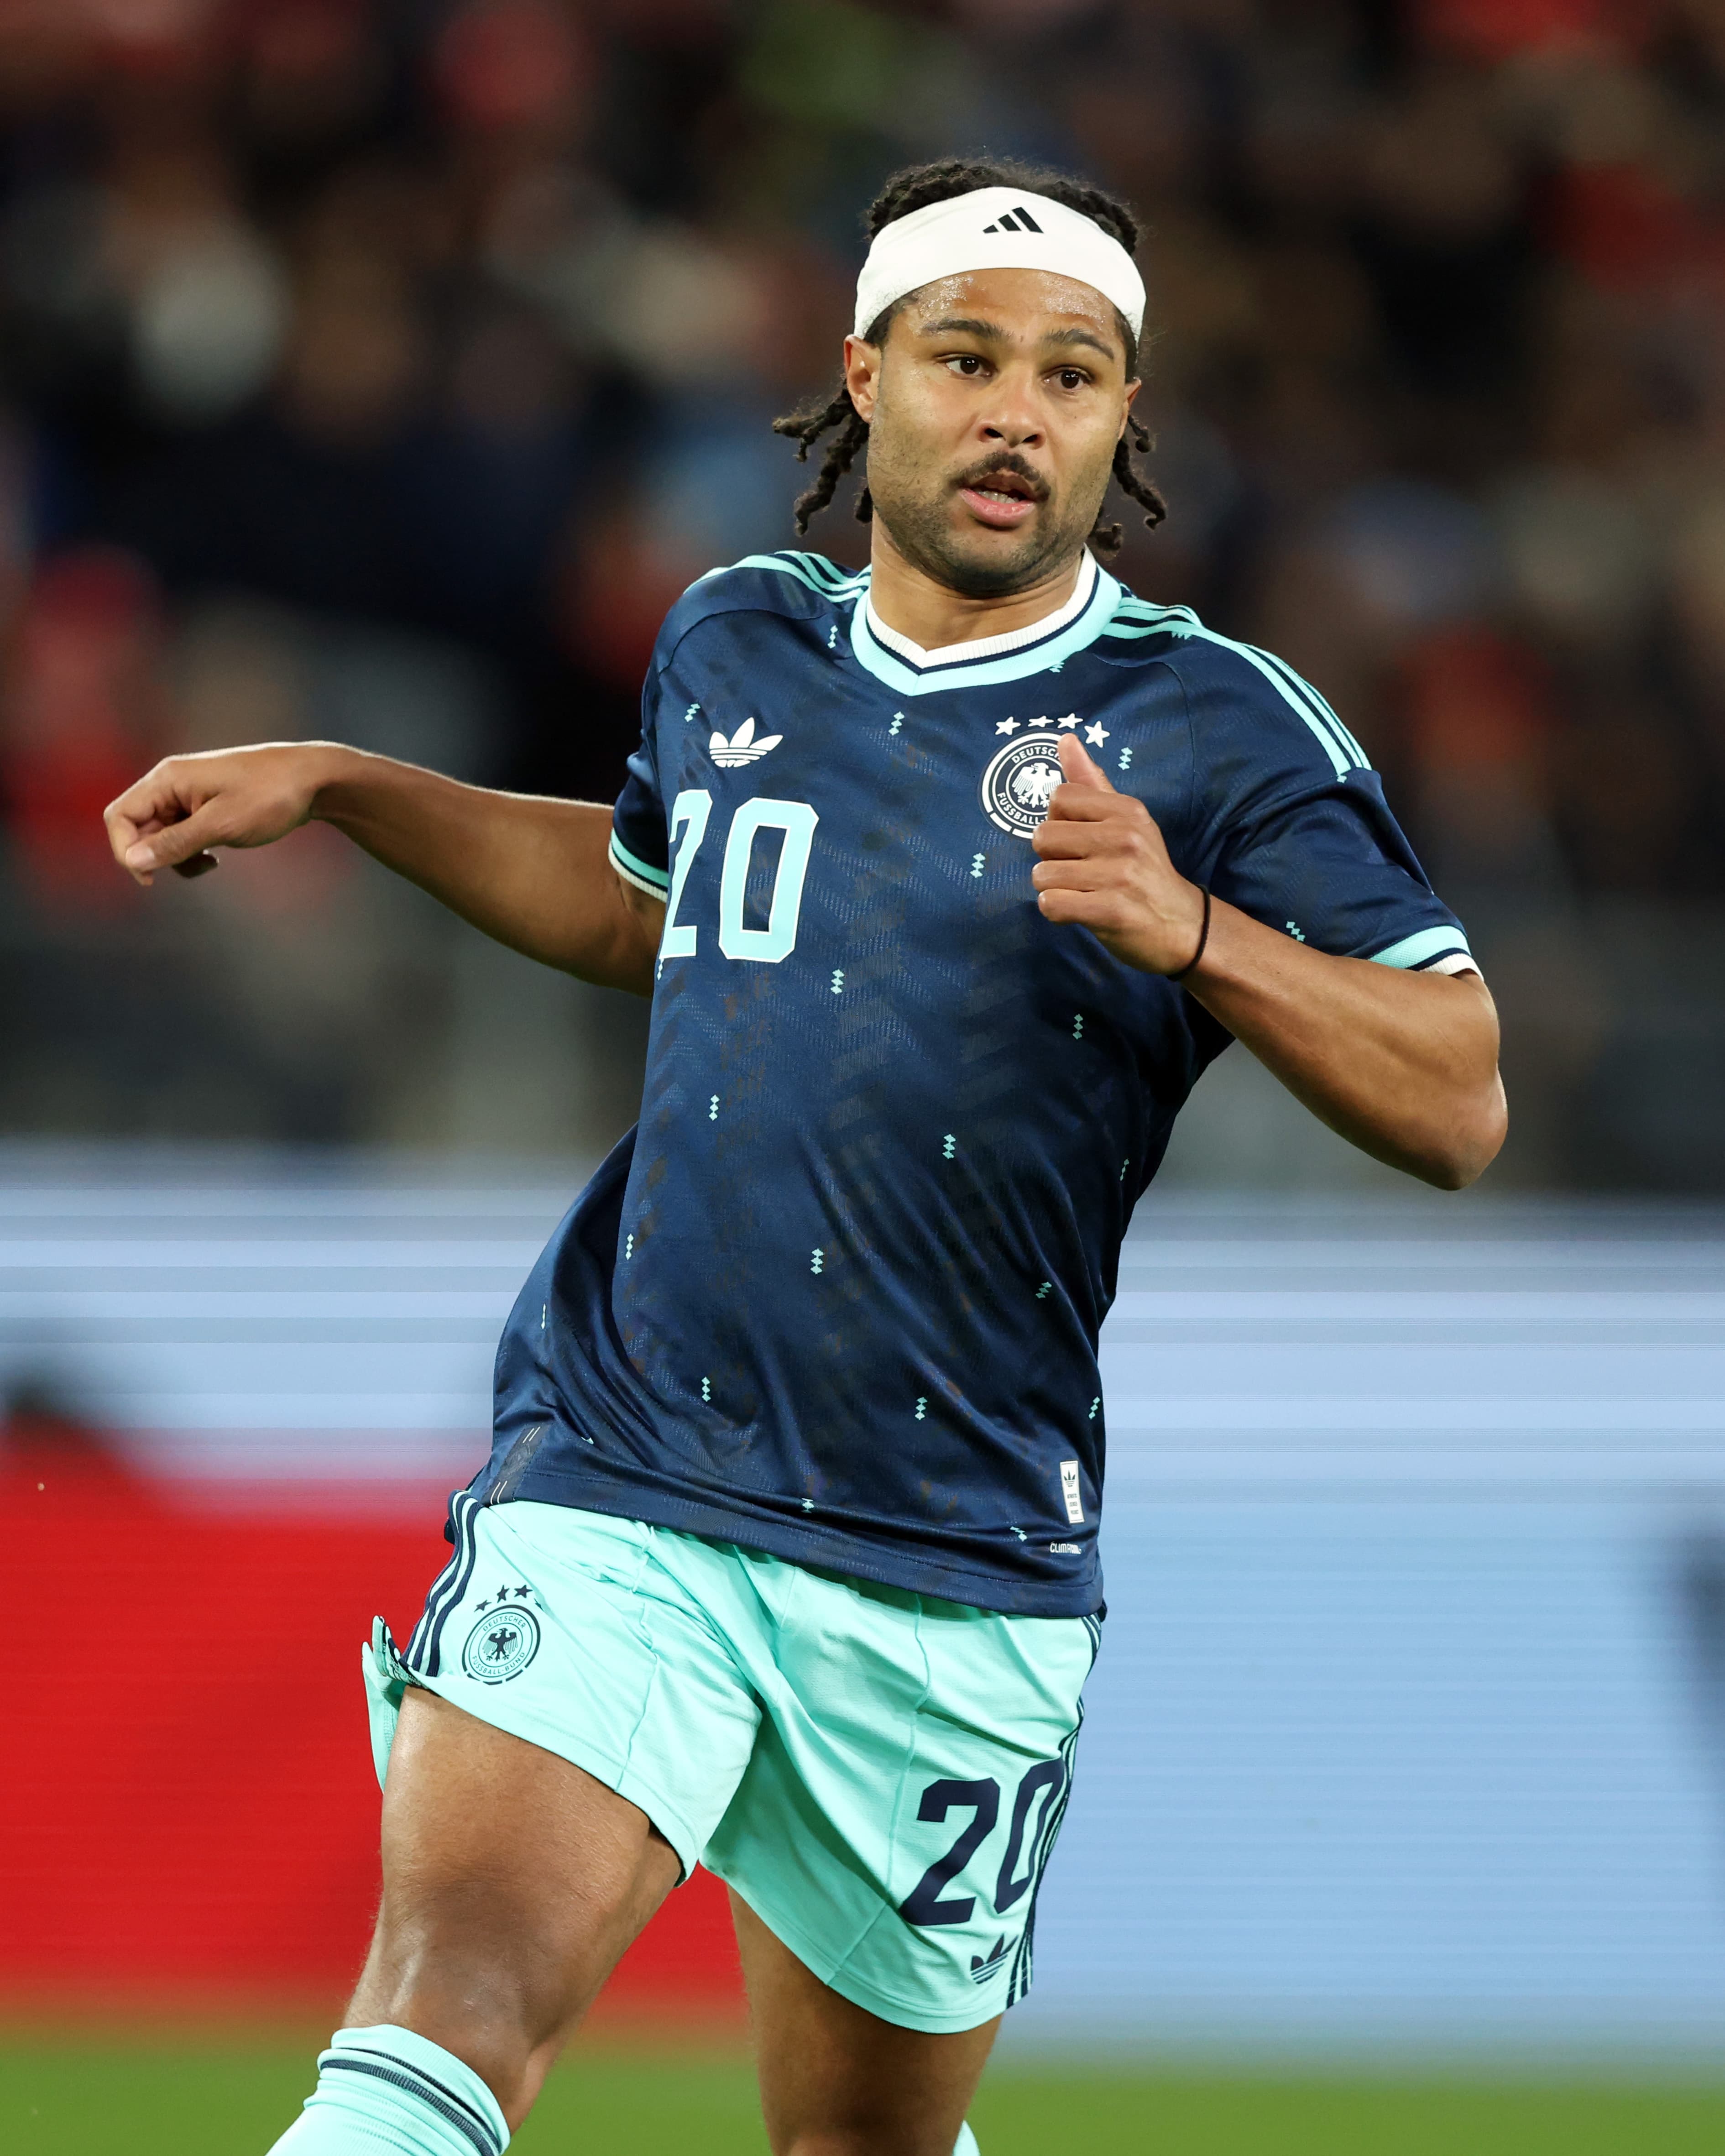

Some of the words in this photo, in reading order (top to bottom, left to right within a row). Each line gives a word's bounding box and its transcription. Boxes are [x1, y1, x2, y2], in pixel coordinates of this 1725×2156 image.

[1011, 747, 1060, 764] DEUTSC
[997, 792, 1048, 824] FUSSBALL-
[659, 789, 819, 963] 20
[483, 1616, 526, 1631] DEUTSCHER
[472, 1652, 525, 1675] FUSSBALL-BUND
[899, 1757, 1065, 1926] 20
